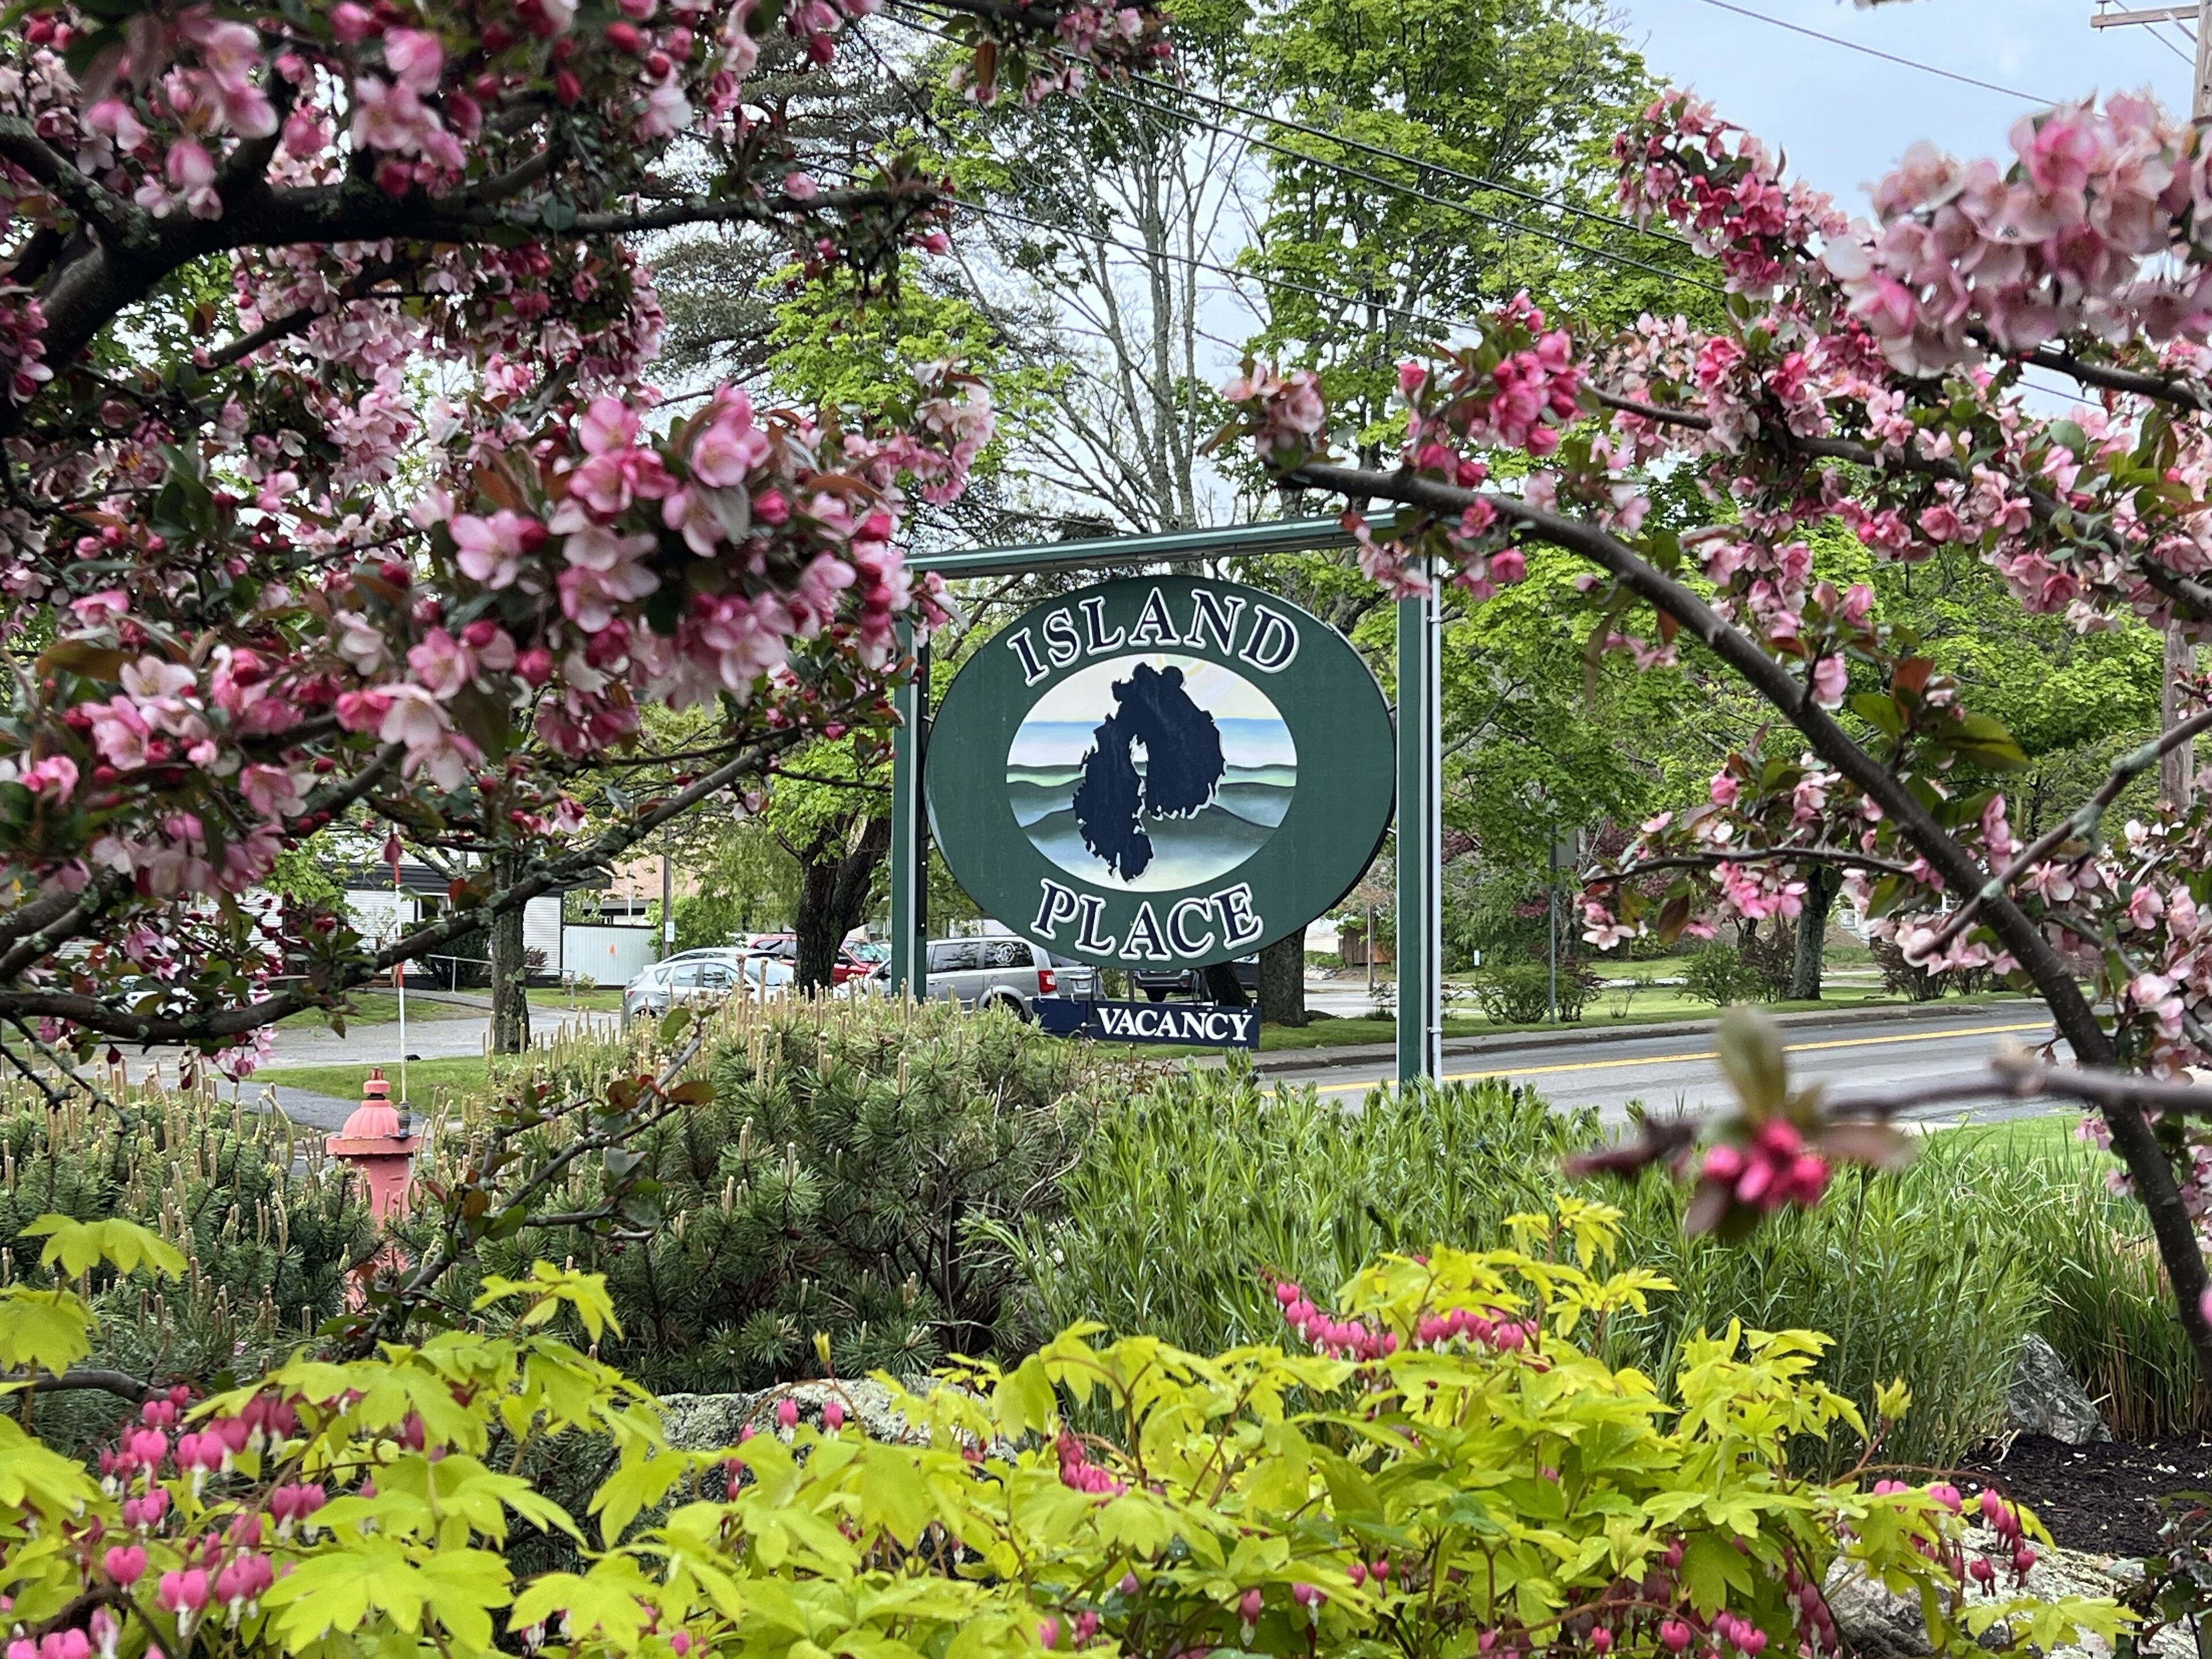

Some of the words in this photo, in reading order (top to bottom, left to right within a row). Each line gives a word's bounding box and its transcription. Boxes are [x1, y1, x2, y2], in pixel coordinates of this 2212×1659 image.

[1007, 587, 1300, 687] ISLAND
[1031, 878, 1263, 961] PLACE
[1097, 1007, 1252, 1041] VACANCY
